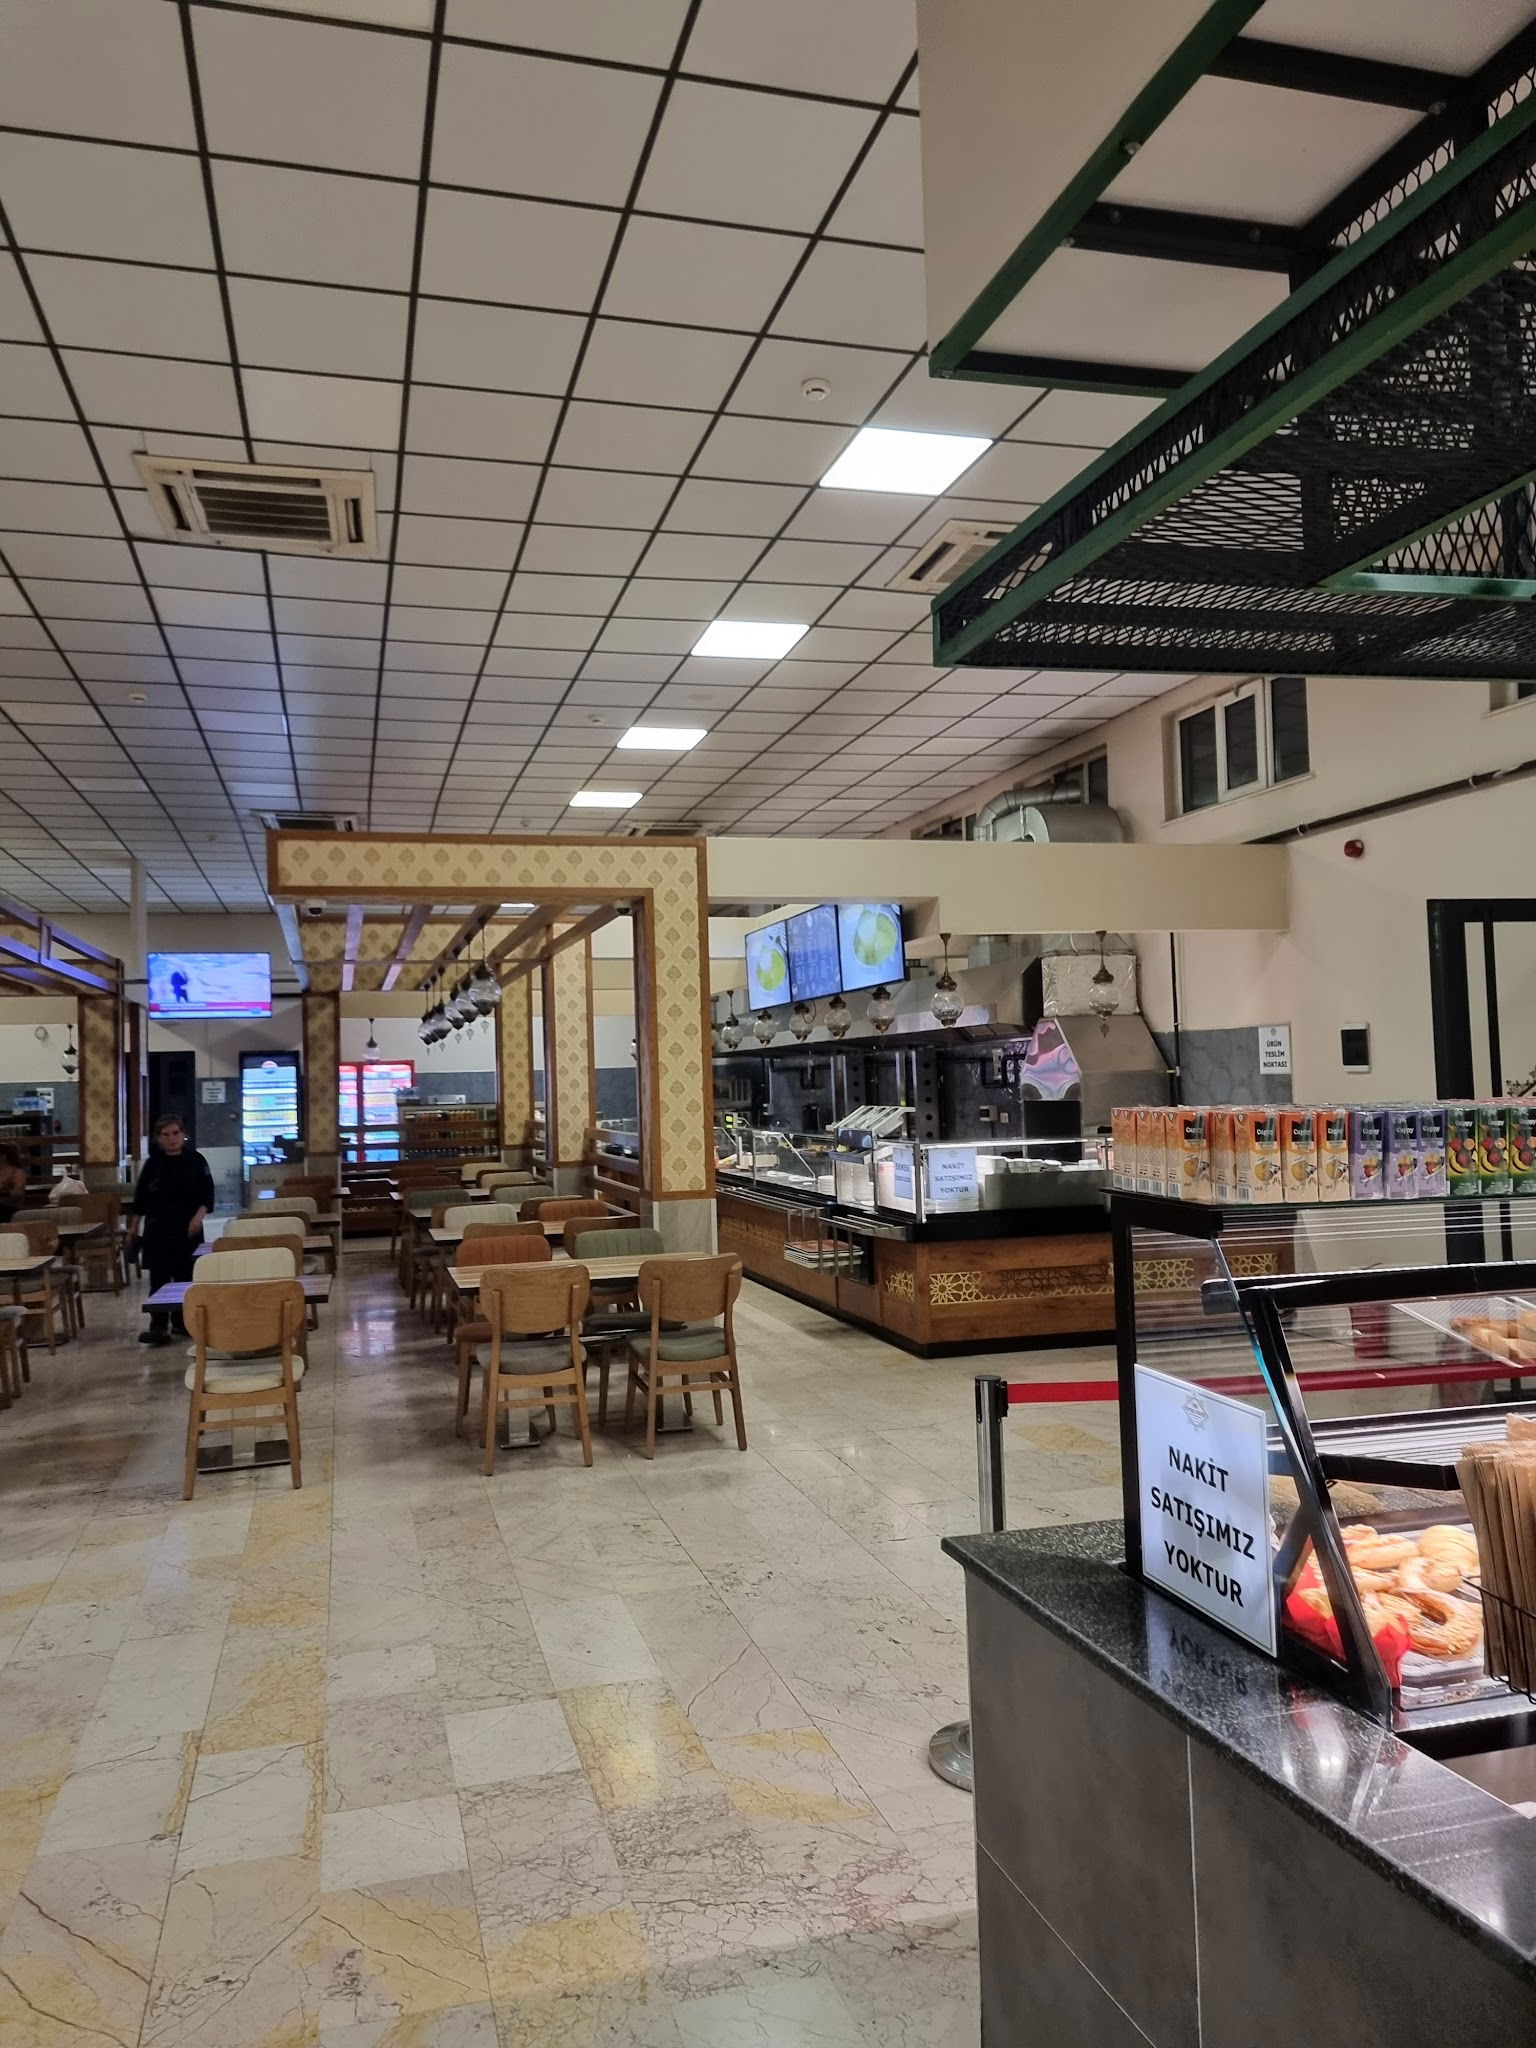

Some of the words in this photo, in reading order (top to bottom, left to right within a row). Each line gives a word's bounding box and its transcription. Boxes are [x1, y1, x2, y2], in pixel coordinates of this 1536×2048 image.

[1263, 1060, 1287, 1068] NOKTASI
[1264, 1050, 1285, 1058] TESLİM
[1168, 1445, 1229, 1493] NAKİT
[1150, 1486, 1256, 1561] SATIŞIMIZ
[1164, 1540, 1245, 1608] YOKTUR
